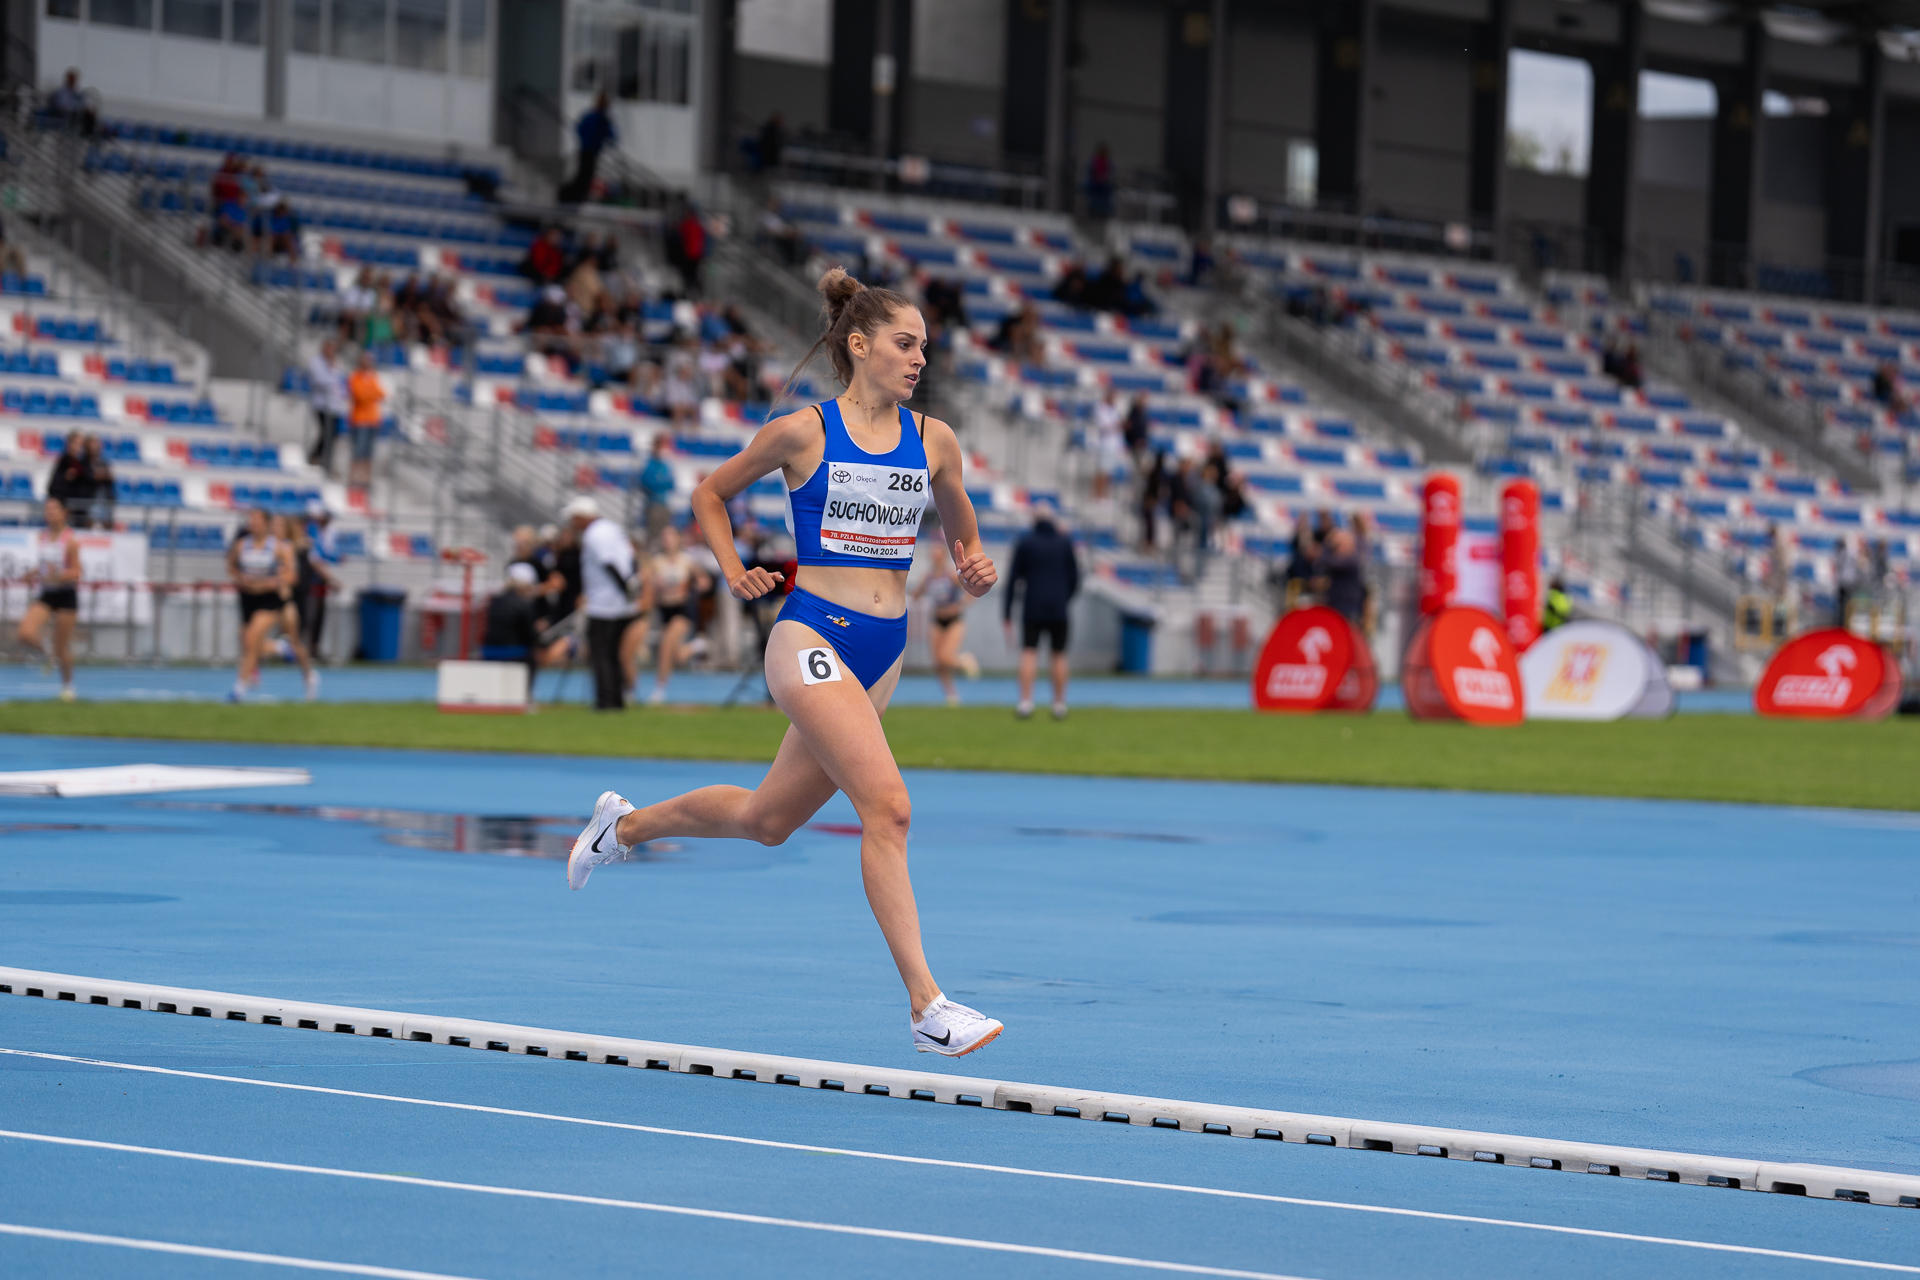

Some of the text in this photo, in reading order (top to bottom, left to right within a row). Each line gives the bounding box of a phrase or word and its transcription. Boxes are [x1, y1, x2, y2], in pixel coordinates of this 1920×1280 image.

[856, 475, 877, 483] Okęcie
[888, 472, 923, 492] 286
[828, 500, 921, 526] SUCHOWOLAK
[855, 535, 887, 544] Mistrzostwa
[843, 543, 879, 555] RADOM
[808, 650, 832, 680] 6
